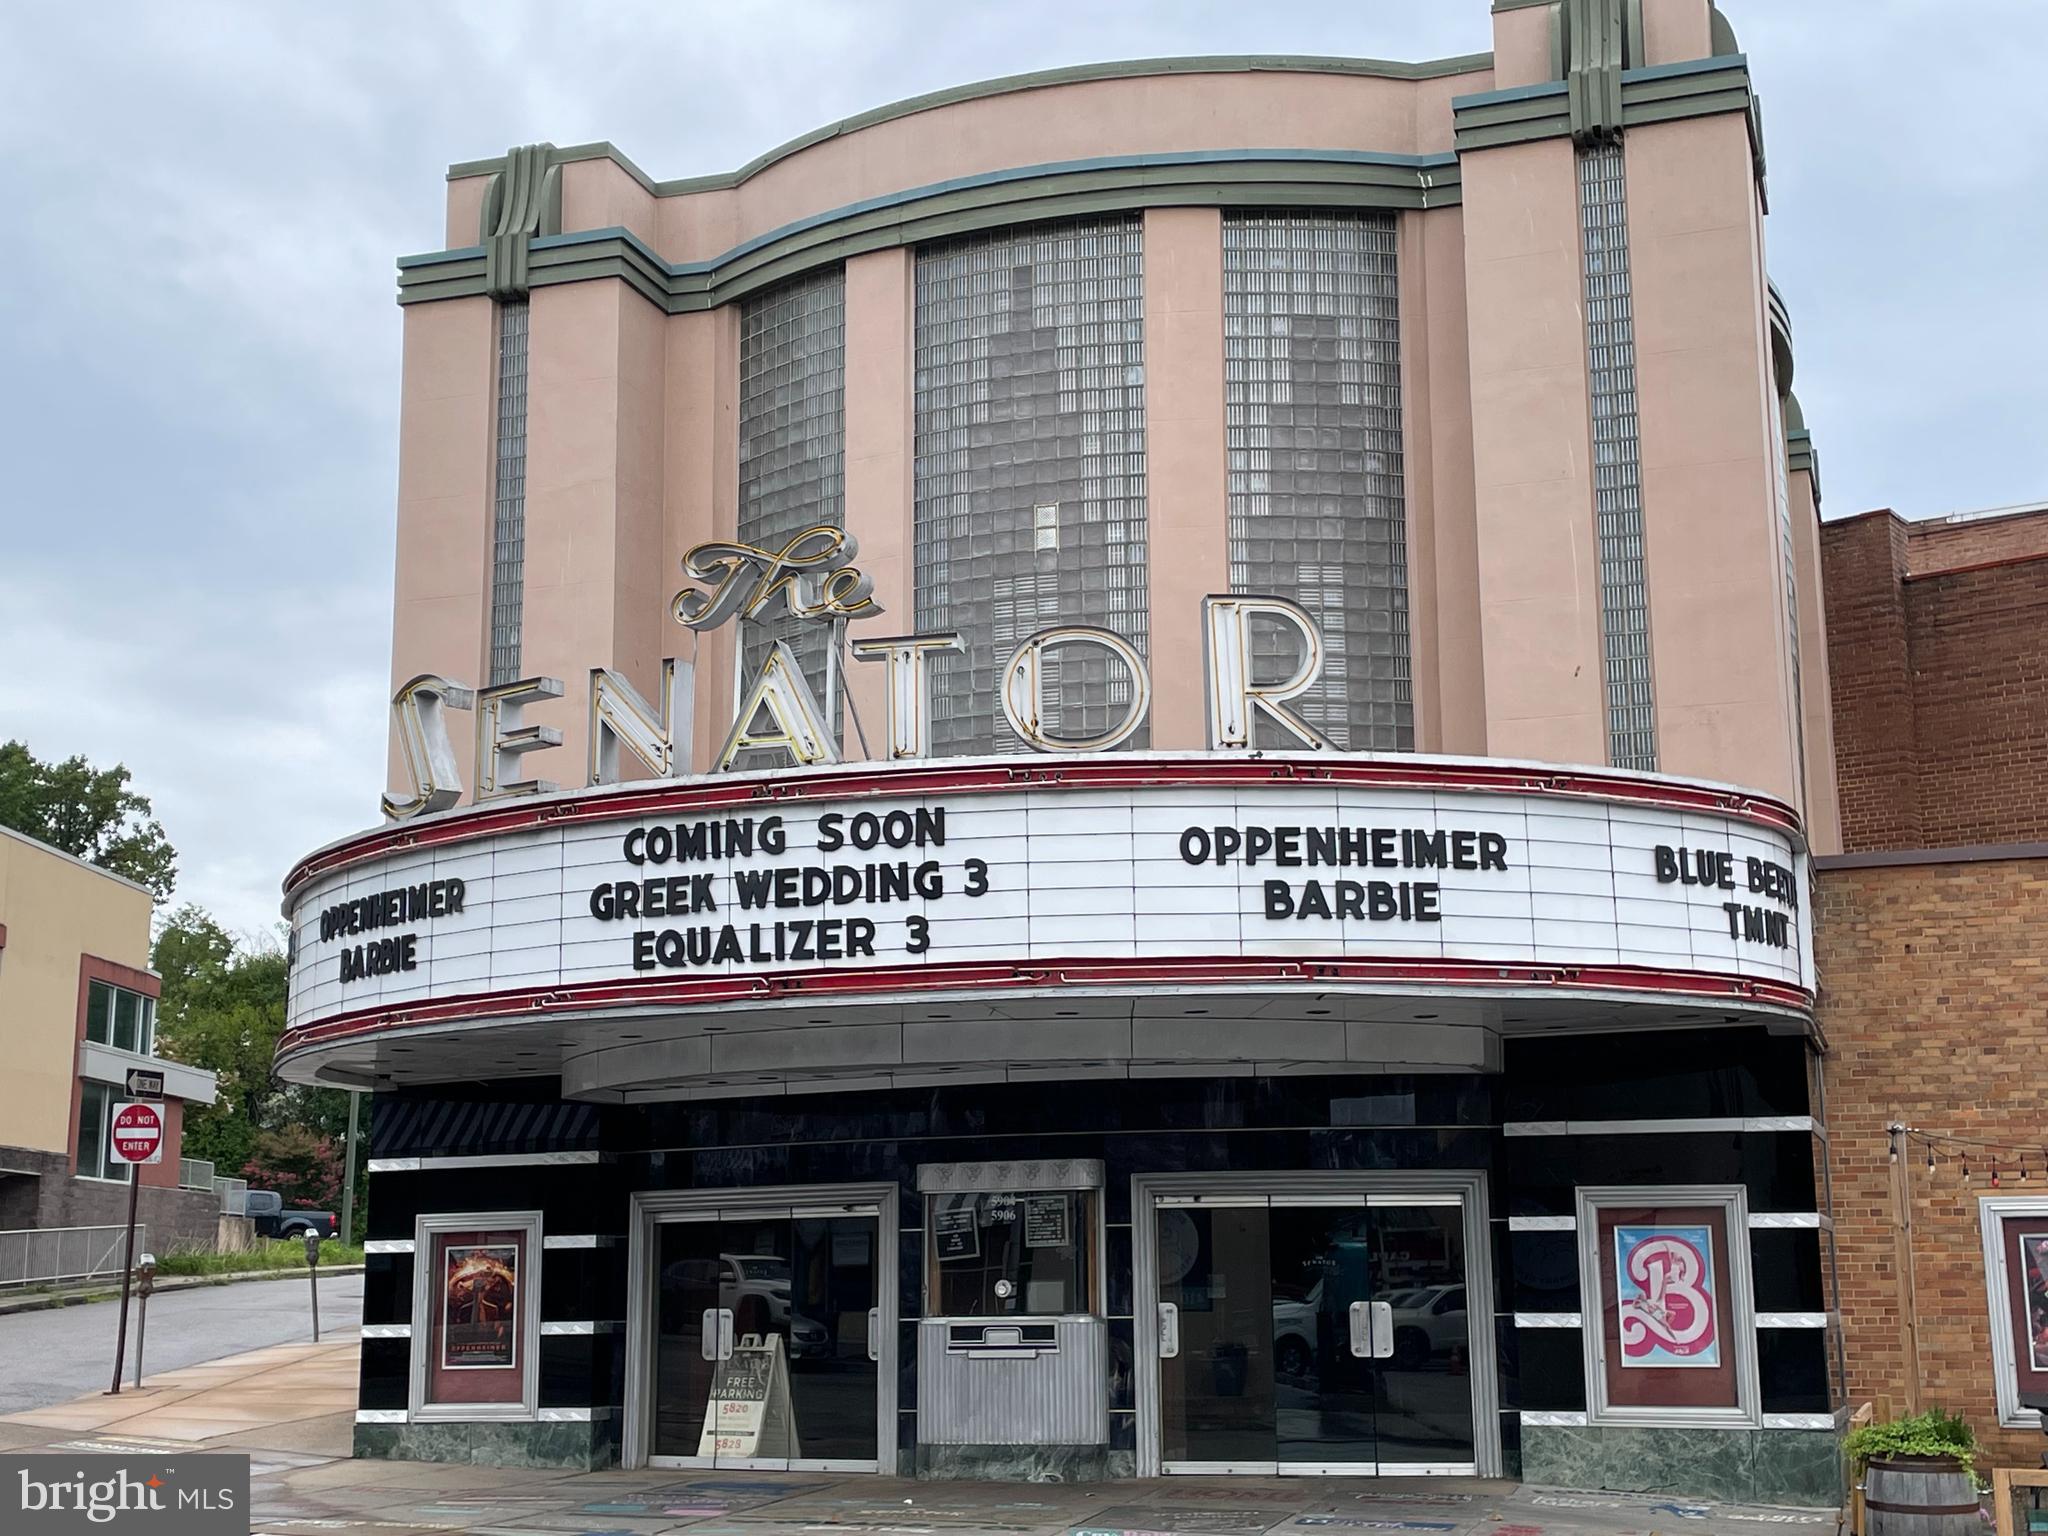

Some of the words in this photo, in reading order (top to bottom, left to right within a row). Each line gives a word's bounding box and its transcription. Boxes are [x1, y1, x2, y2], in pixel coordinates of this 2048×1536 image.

[671, 525, 886, 632] The
[381, 593, 1345, 820] SENATOR
[623, 816, 786, 865] COMING
[817, 807, 945, 852] SOON
[1180, 826, 1508, 871] OPPENHEIMER
[590, 872, 717, 921] GREEK
[734, 860, 944, 910] WEDDING
[964, 858, 989, 897] 3
[1264, 880, 1442, 921] BARBIE
[1655, 845, 1736, 889] BLUE
[1747, 856, 1798, 911] BEET
[320, 878, 465, 943] OPPENHEIMER
[1723, 902, 1789, 950] TMNT
[339, 934, 417, 984] BARBIE
[633, 918, 876, 970] EQUALIZER
[905, 915, 930, 954] 3
[137, 1079, 147, 1089] ONE
[120, 1115, 132, 1125] DO
[138, 1115, 155, 1125] NOT
[122, 1141, 150, 1152] ENTER
[991, 1210, 1016, 1221] 5906
[712, 1388, 763, 1400] PARKING
[727, 1377, 756, 1387] FREE
